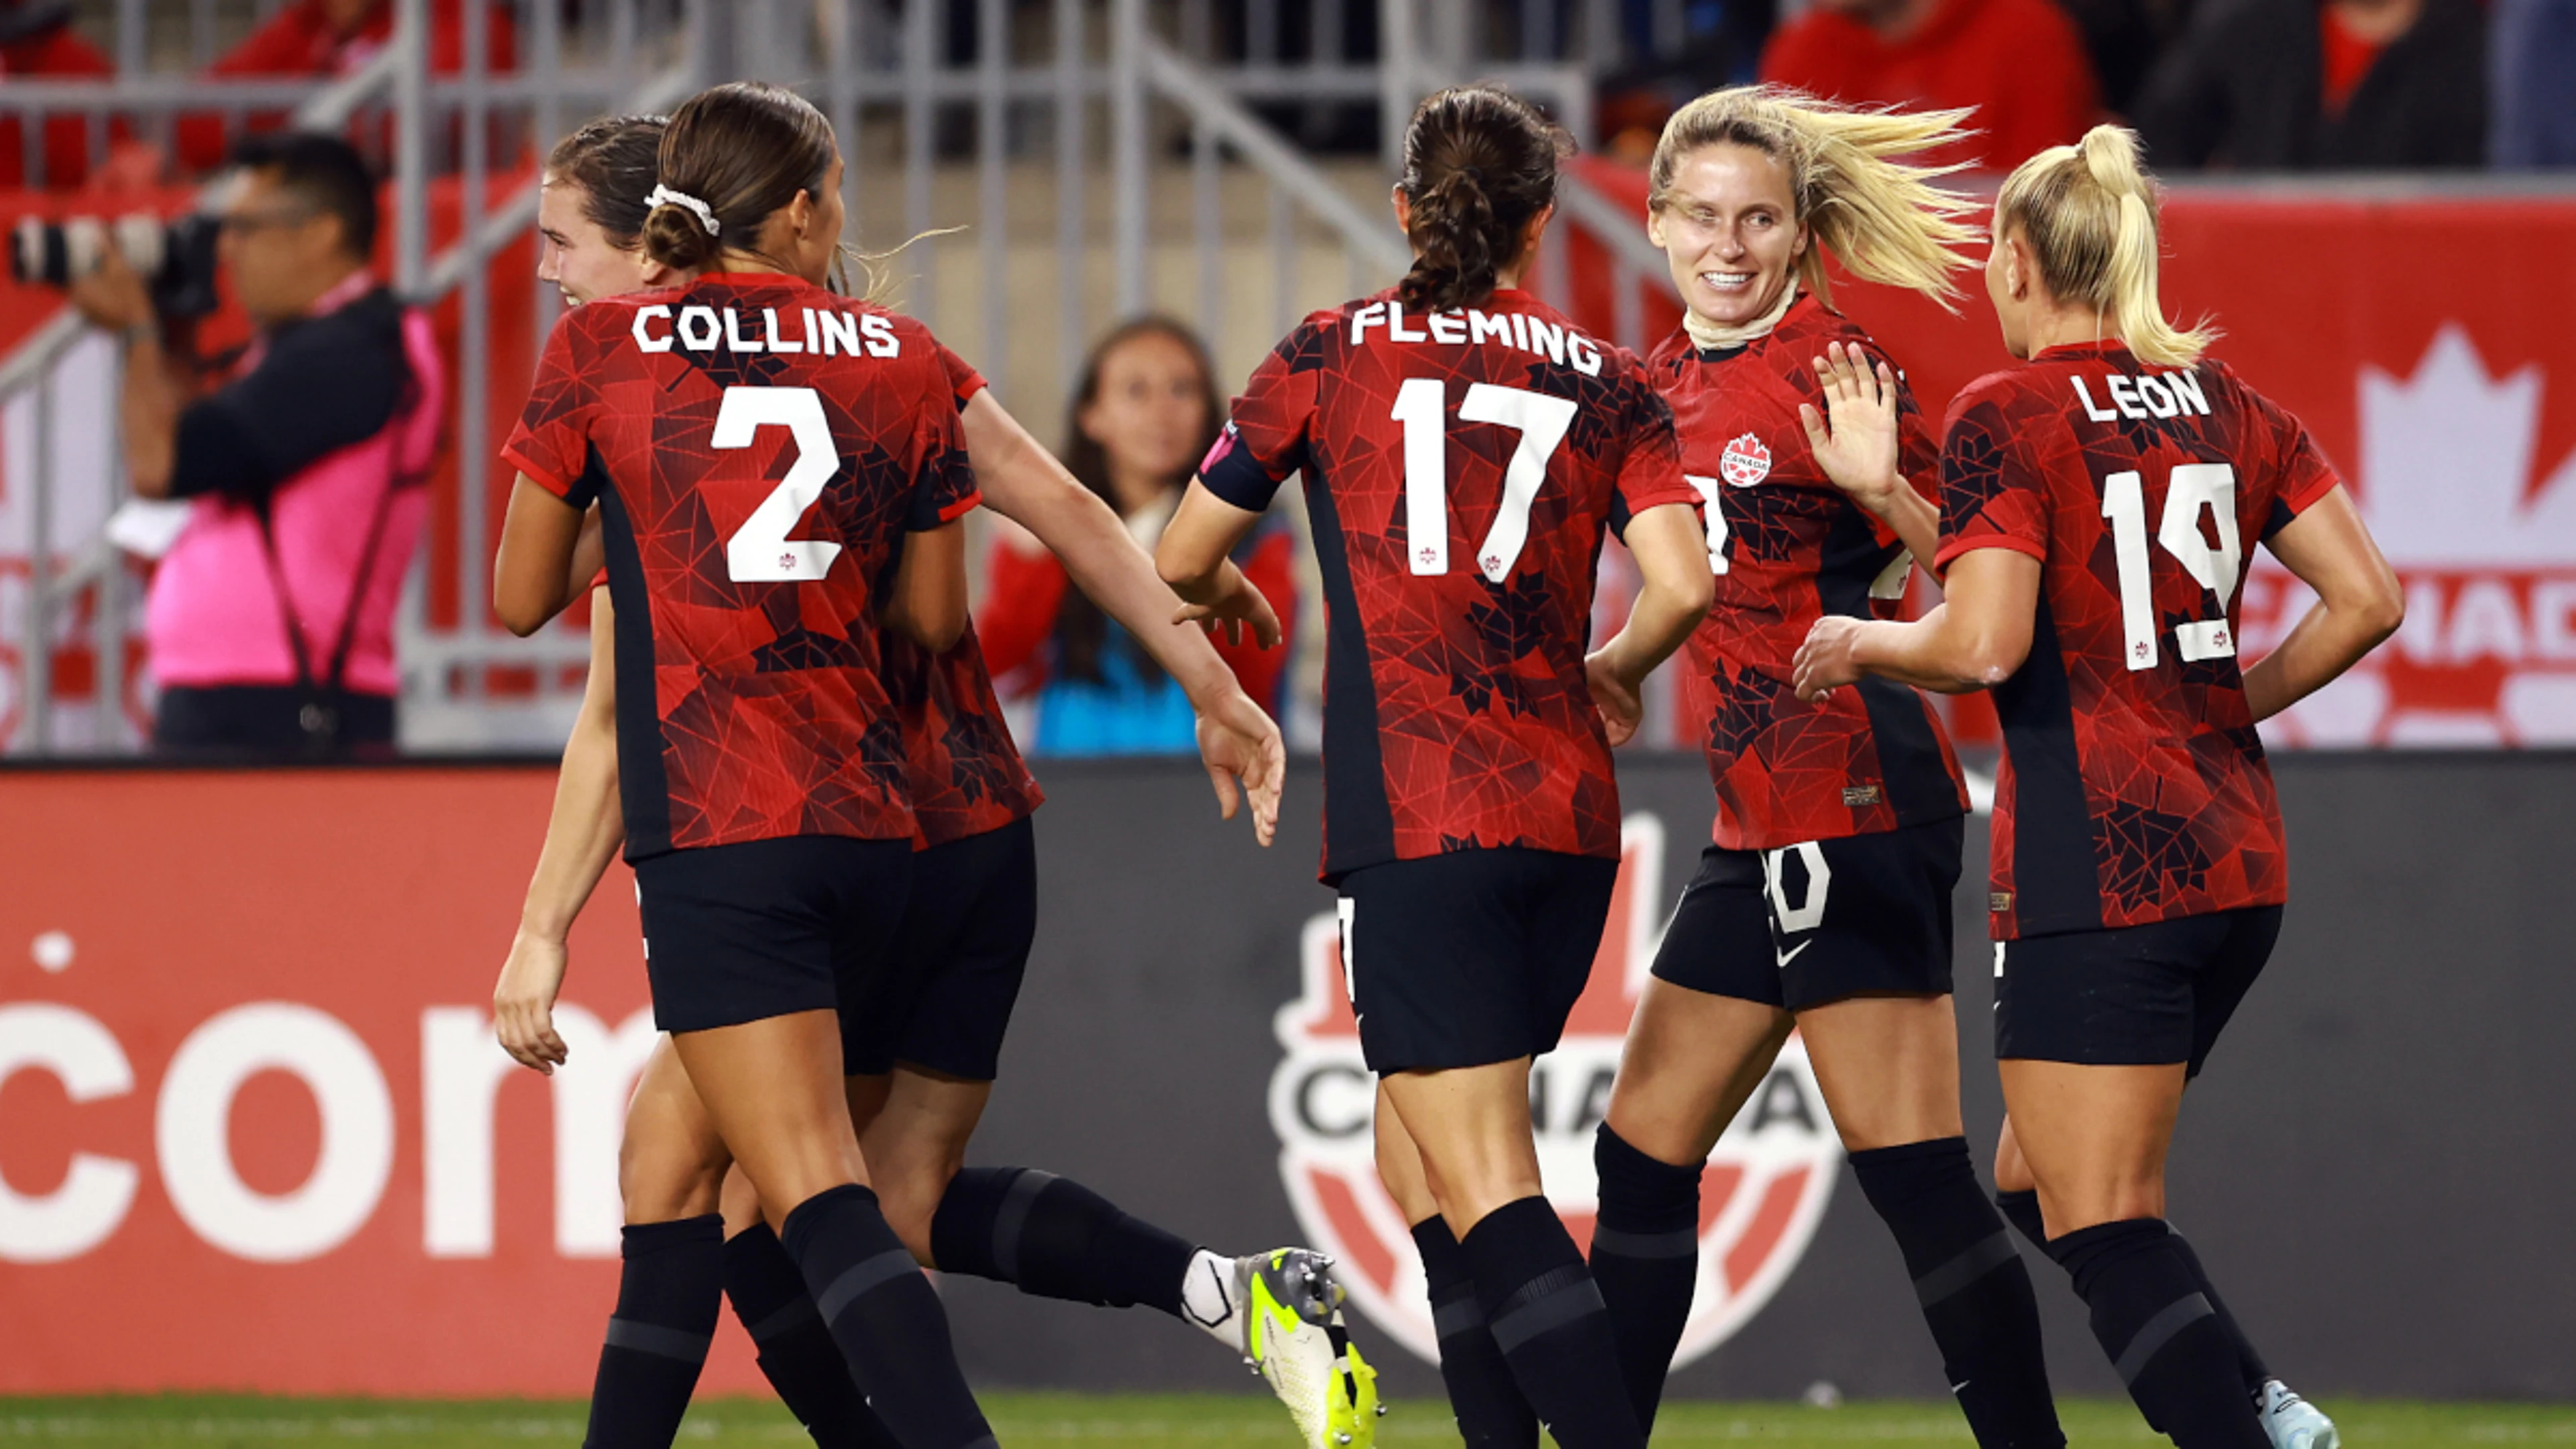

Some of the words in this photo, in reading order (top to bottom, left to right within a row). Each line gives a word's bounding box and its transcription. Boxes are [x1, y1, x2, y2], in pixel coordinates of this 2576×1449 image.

[631, 305, 900, 358] COLLINS
[1350, 300, 1602, 377] FLEMING
[2070, 369, 2212, 422] LEON
[710, 386, 842, 582] 2
[1391, 378, 1578, 583] 17
[1723, 452, 1768, 471] CANADA
[2102, 463, 2241, 671] 19
[1759, 841, 1831, 933] 0
